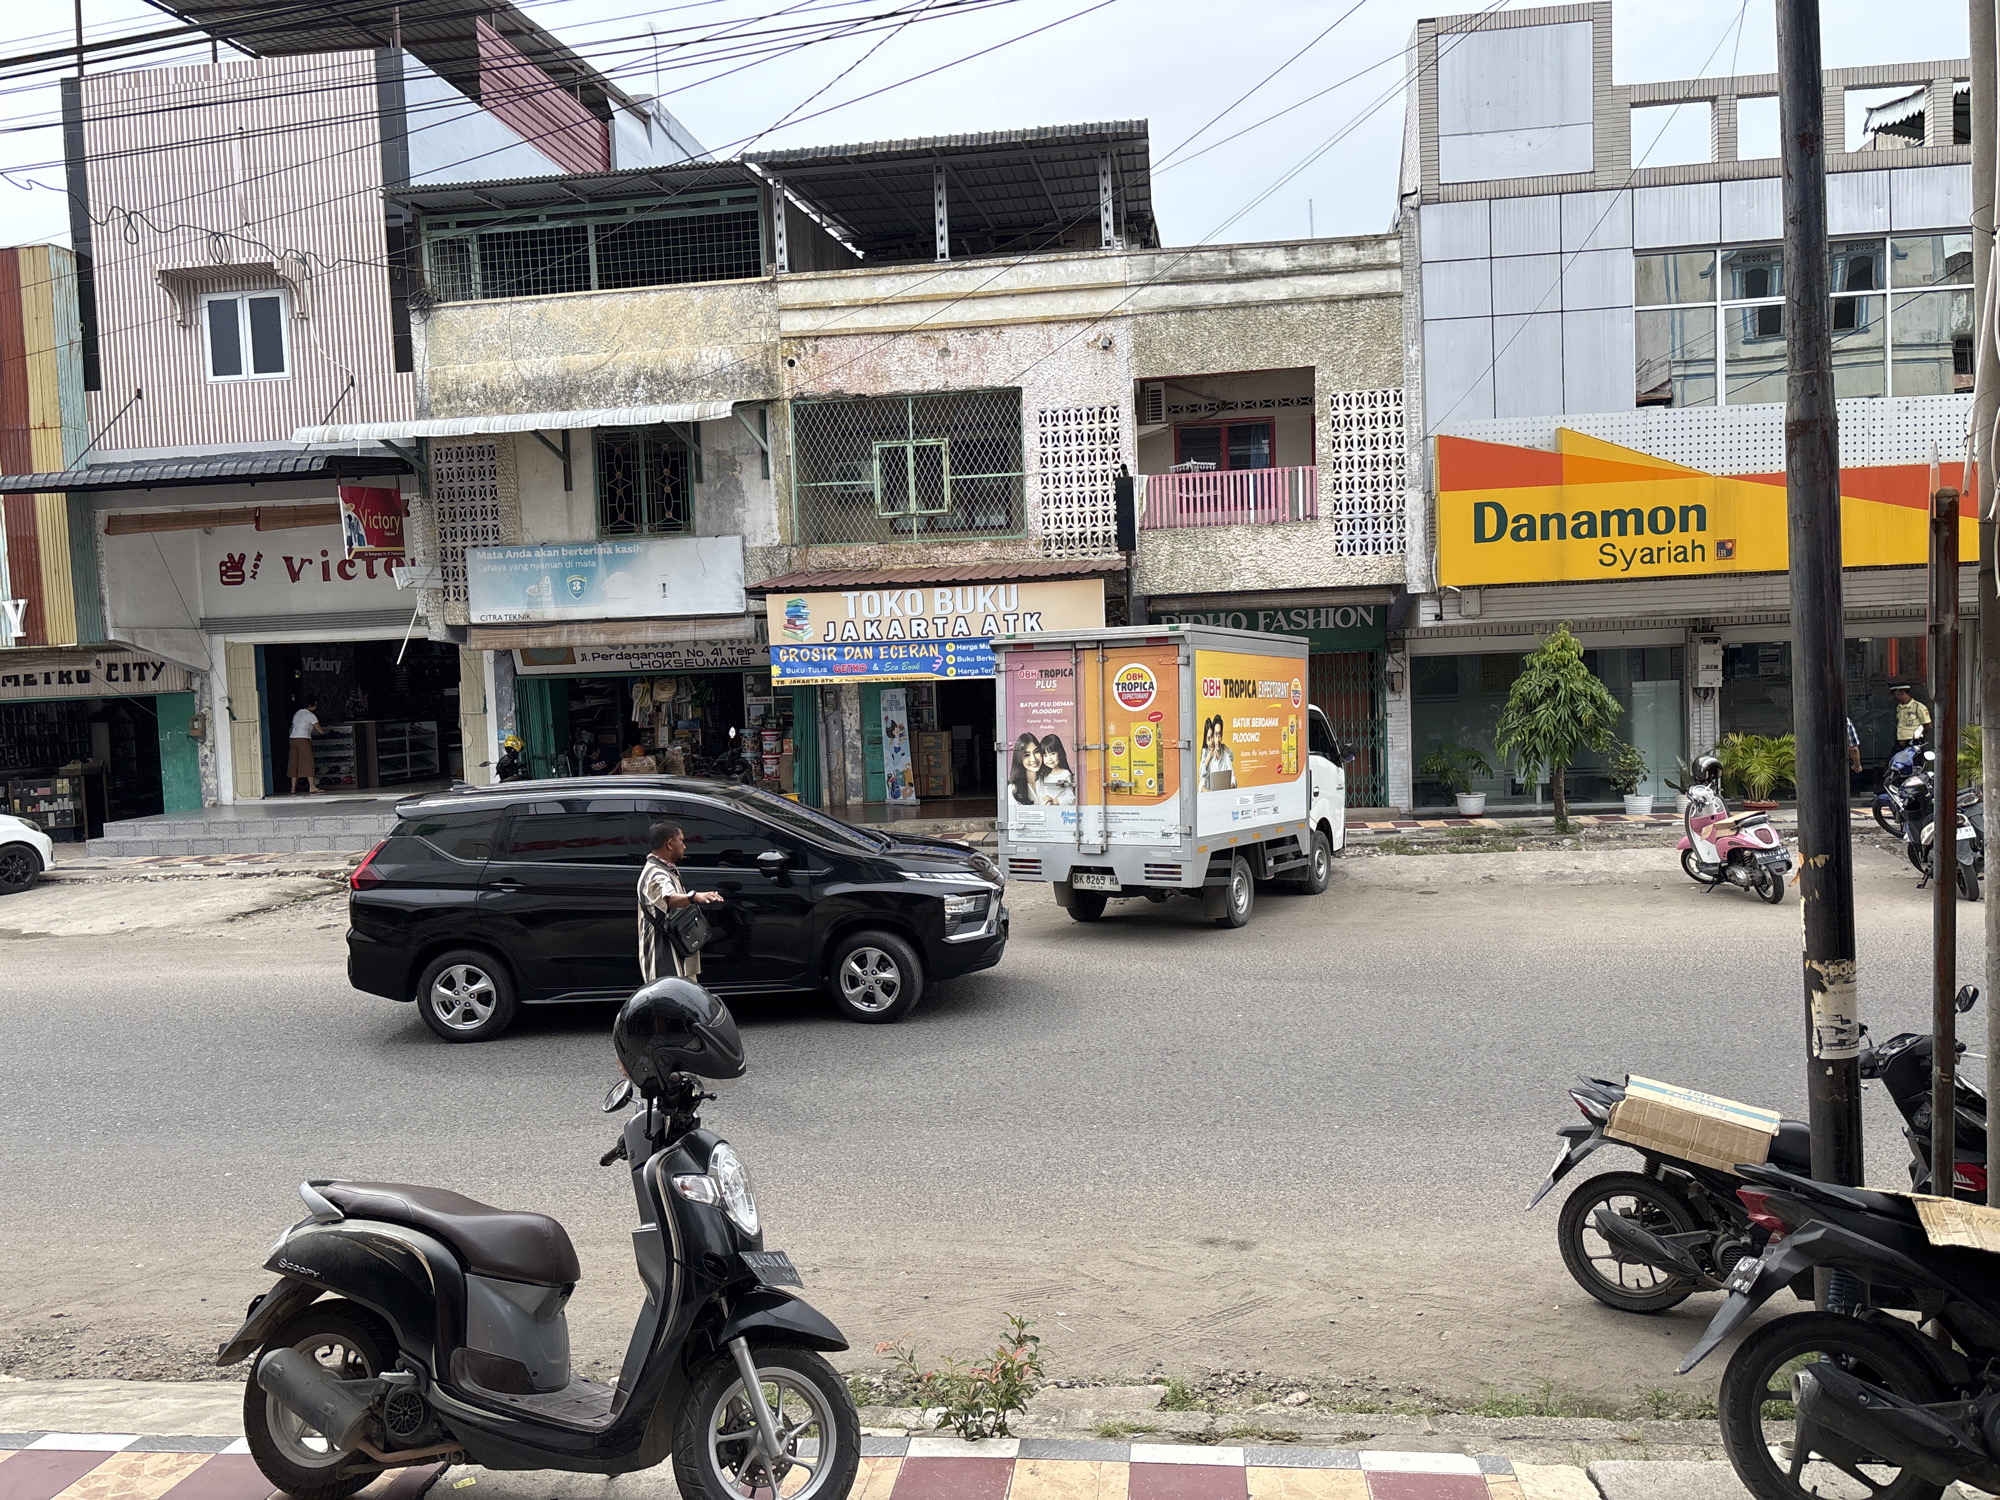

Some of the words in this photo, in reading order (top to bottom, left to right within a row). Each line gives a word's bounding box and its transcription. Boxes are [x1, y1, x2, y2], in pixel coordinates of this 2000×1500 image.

[359, 509, 400, 535] Victory
[1474, 501, 1706, 544] Danamon
[476, 551, 503, 560] Mata
[506, 549, 531, 559] Anda
[534, 548, 559, 558] akan
[562, 546, 613, 557] berterima
[615, 545, 642, 555] kasih
[1599, 539, 1705, 572] Syariah
[509, 563, 528, 572] yang
[530, 562, 563, 571] nyaman
[565, 560, 573, 568] di
[575, 560, 596, 568] mata
[572, 581, 581, 590] 3
[841, 590, 926, 619] TOKO
[934, 584, 1019, 615] BUKU
[3, 600, 28, 637] Y
[480, 614, 502, 622] CITRA
[504, 613, 531, 621] TEKNIK
[1257, 605, 1375, 632] FASHION
[823, 615, 974, 642] JAKARTA
[981, 612, 1043, 635] ATK
[686, 648, 706, 658] No.
[728, 646, 757, 657] Telp.
[779, 646, 837, 663] GROSIR
[844, 646, 873, 660] DAN
[879, 644, 938, 660] ECERAN
[956, 644, 978, 652] Harga
[302, 657, 341, 675] Victory
[629, 657, 751, 669] LHOKSEUMAWE
[833, 663, 868, 674] GETKO
[872, 663, 879, 671] &
[884, 662, 899, 672] Eco
[901, 661, 920, 671] Book
[106, 662, 165, 683] CITY
[980, 667, 996, 675] Terj
[1018, 670, 1037, 679] OBH
[1039, 669, 1073, 678] TROPICA
[1126, 673, 1143, 681] OBH
[1036, 680, 1057, 689] PLUS
[1115, 681, 1155, 692] TROPICA
[1202, 677, 1221, 699] OBH
[1223, 678, 1257, 699] TROPICA
[1121, 692, 1149, 700] EXPECTORANT
[1232, 718, 1251, 728] BATUK
[1074, 874, 1084, 884] BK
[1666, 1090, 1688, 1101] Fan
[1691, 1097, 1728, 1110] Motor
[1684, 1090, 1716, 1101] JMC
